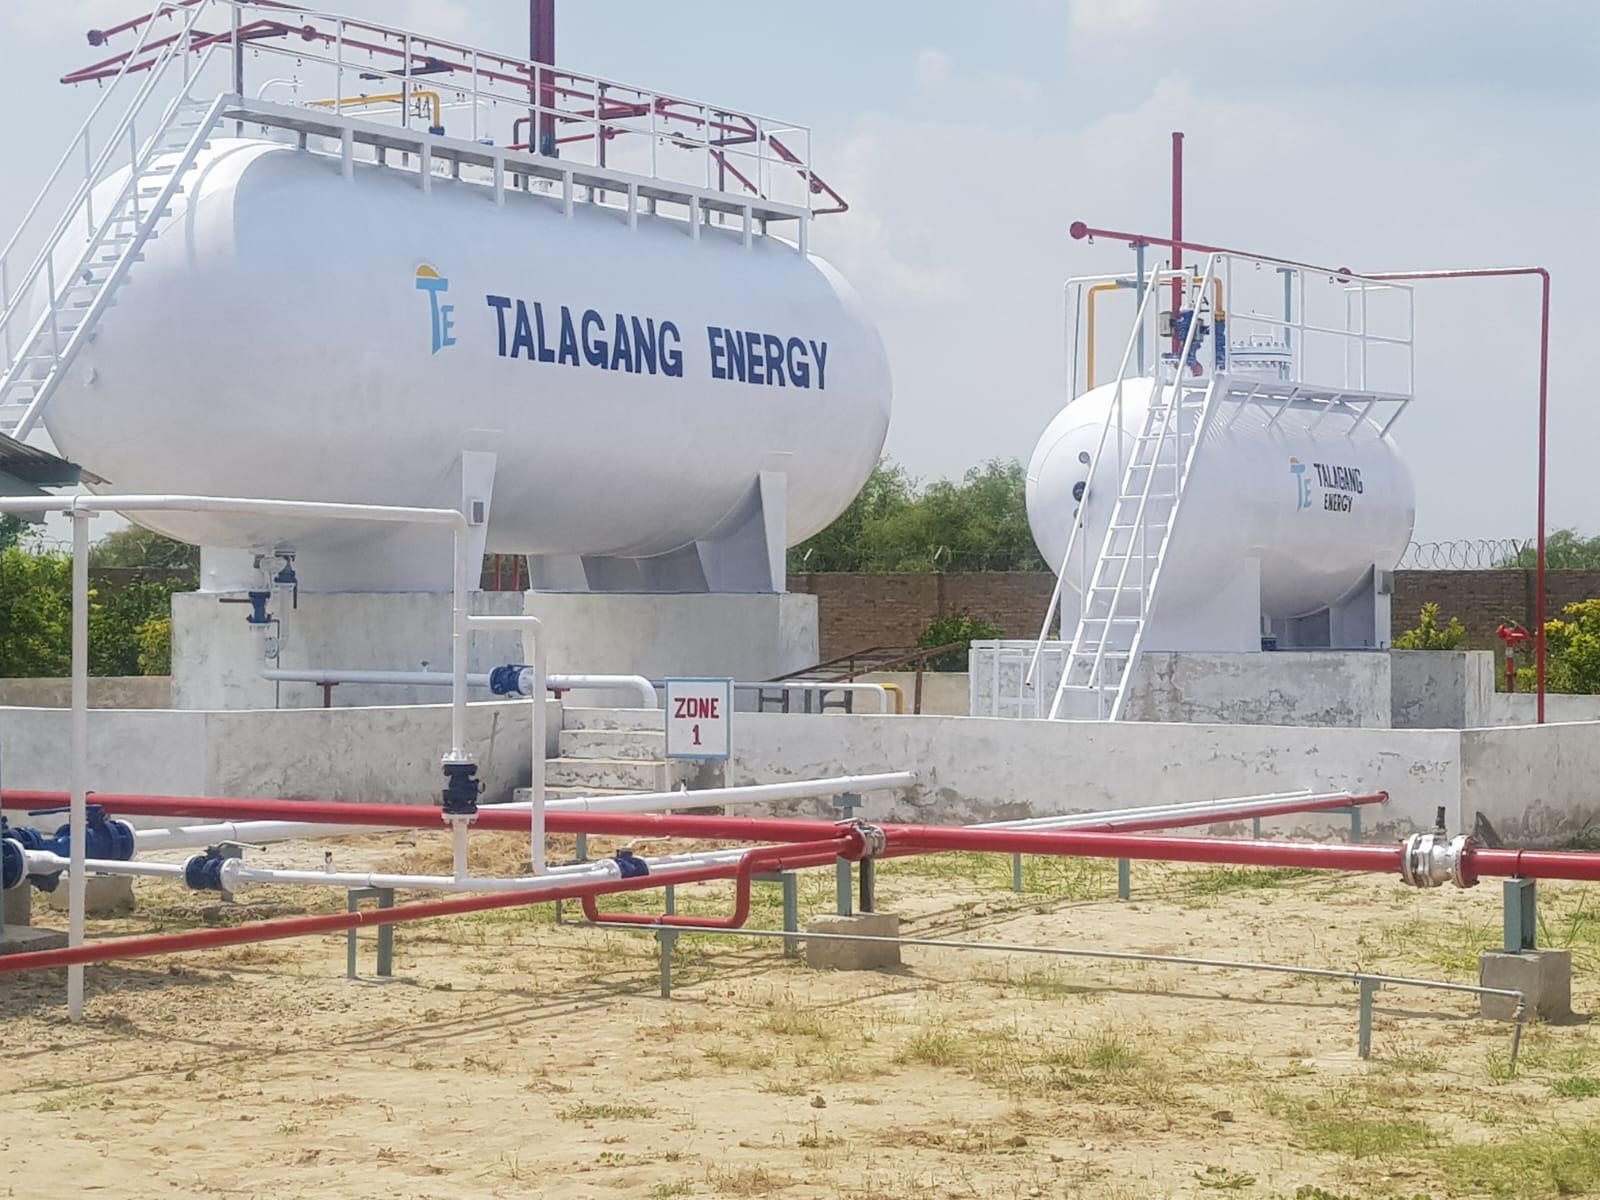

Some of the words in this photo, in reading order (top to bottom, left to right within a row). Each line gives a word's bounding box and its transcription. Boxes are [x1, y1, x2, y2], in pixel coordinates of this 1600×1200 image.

[486, 294, 683, 378] TALAGANG
[706, 325, 828, 390] ENERGY
[1313, 462, 1363, 494] TALAGANG
[1324, 493, 1353, 513] ENERGY
[674, 697, 719, 719] ZONE
[692, 724, 702, 745] 1
